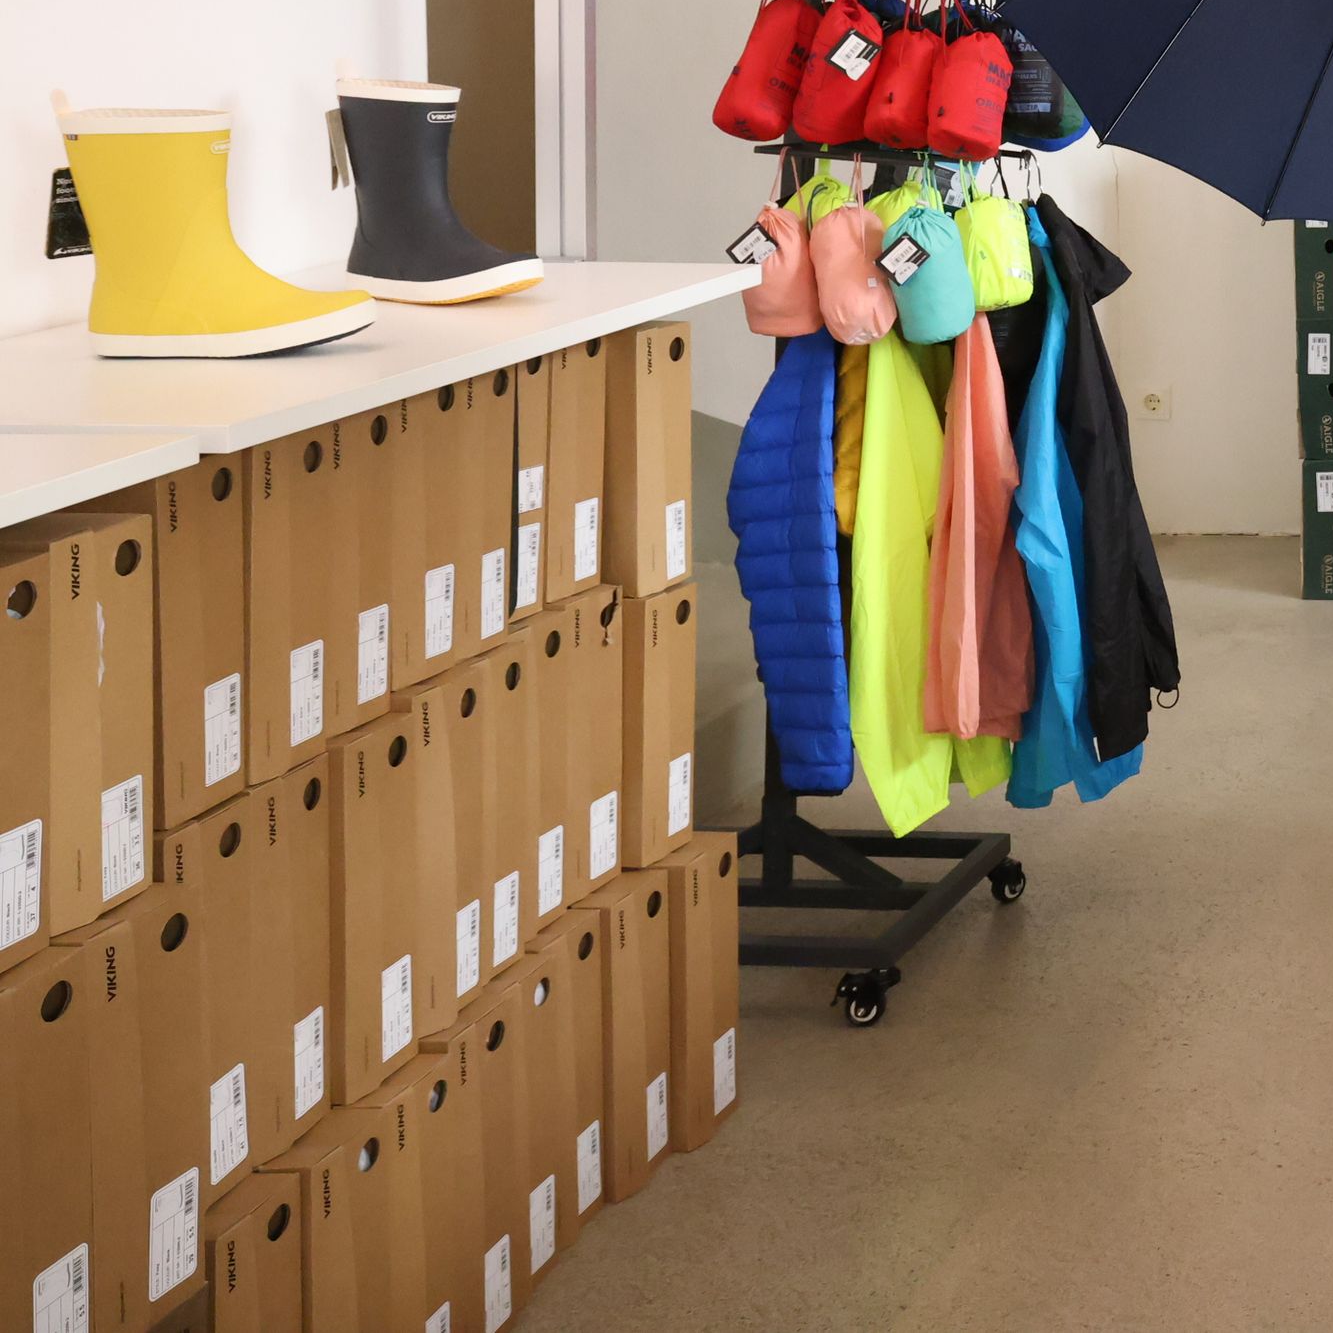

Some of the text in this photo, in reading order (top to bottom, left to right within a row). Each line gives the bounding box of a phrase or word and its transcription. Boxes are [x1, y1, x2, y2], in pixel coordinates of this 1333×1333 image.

[1324, 426, 1333, 453] AIGLE
[169, 482, 177, 532] VIKING
[71, 544, 80, 599] VIKING
[422, 702, 430, 746] VIKING
[268, 797, 276, 845] VIKING
[106, 947, 116, 1002] VIKING
[228, 1241, 236, 1292] VIKING
